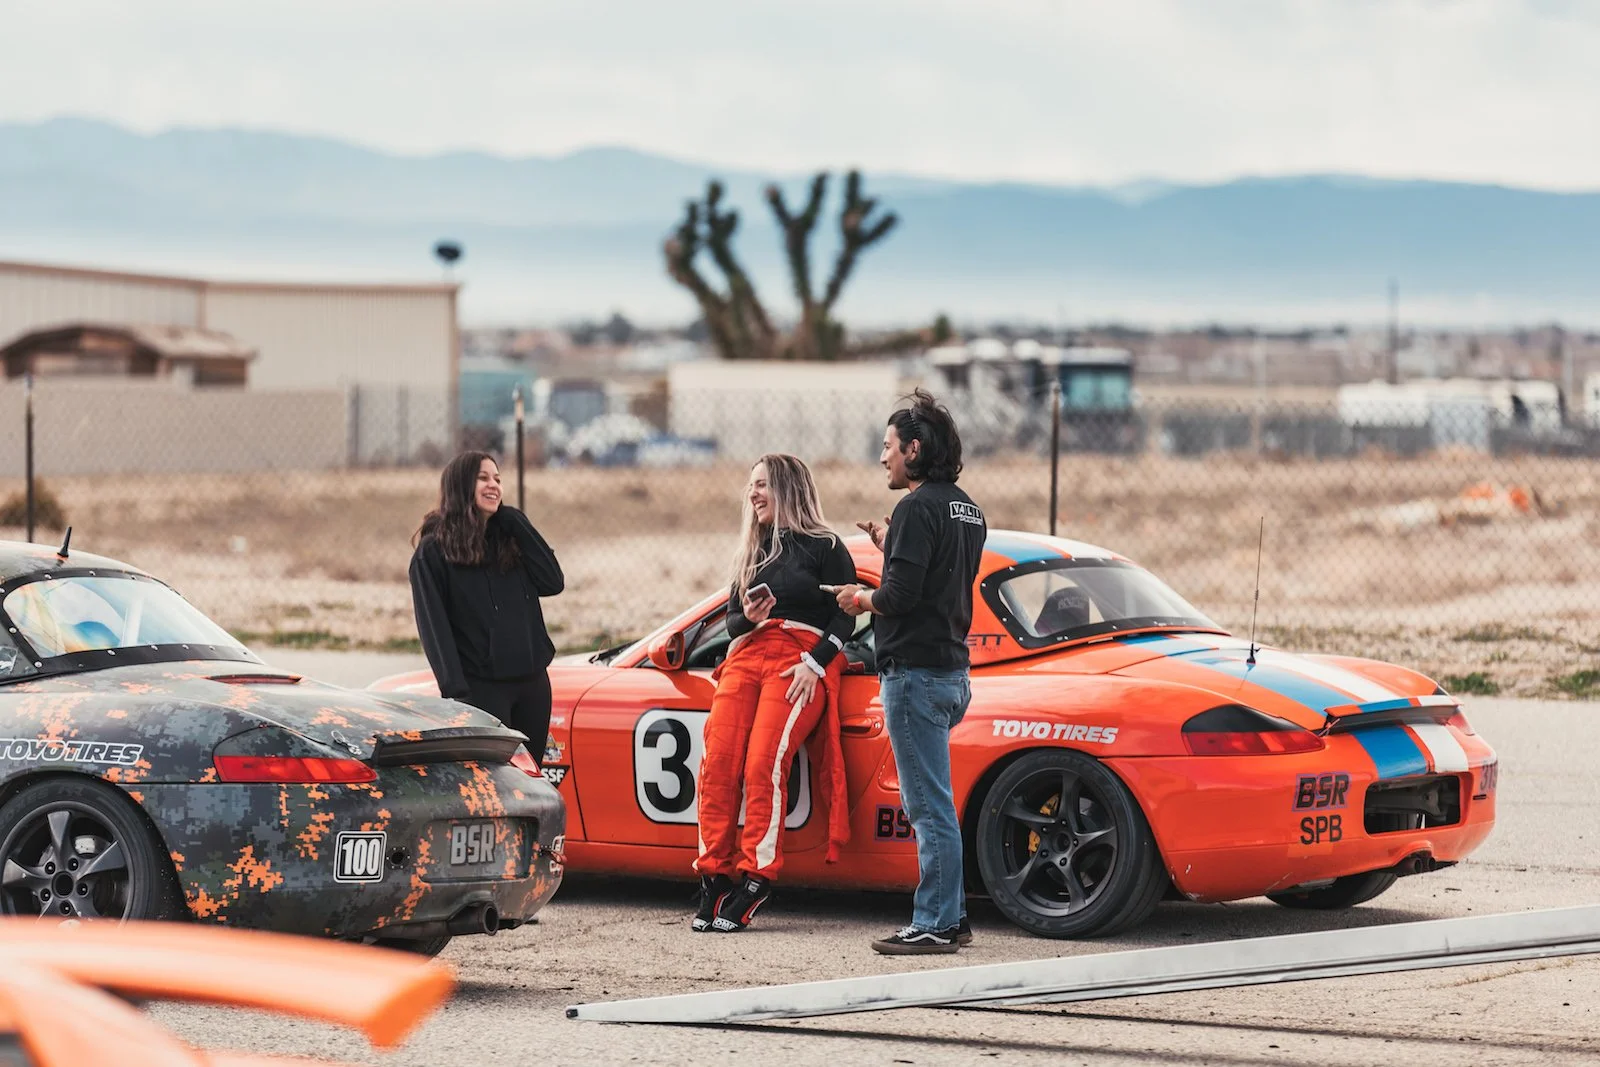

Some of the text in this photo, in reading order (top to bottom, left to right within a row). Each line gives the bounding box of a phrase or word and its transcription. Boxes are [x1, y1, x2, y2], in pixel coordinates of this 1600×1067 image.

[992, 719, 1119, 744] TOYO TIRES
[0, 738, 144, 765] TOYO TIRES
[540, 768, 565, 783] SSF
[1295, 773, 1350, 809] BSR
[877, 806, 917, 839] BS
[1300, 814, 1343, 845] SPB
[342, 838, 381, 876] 100
[451, 823, 496, 865] BSR
